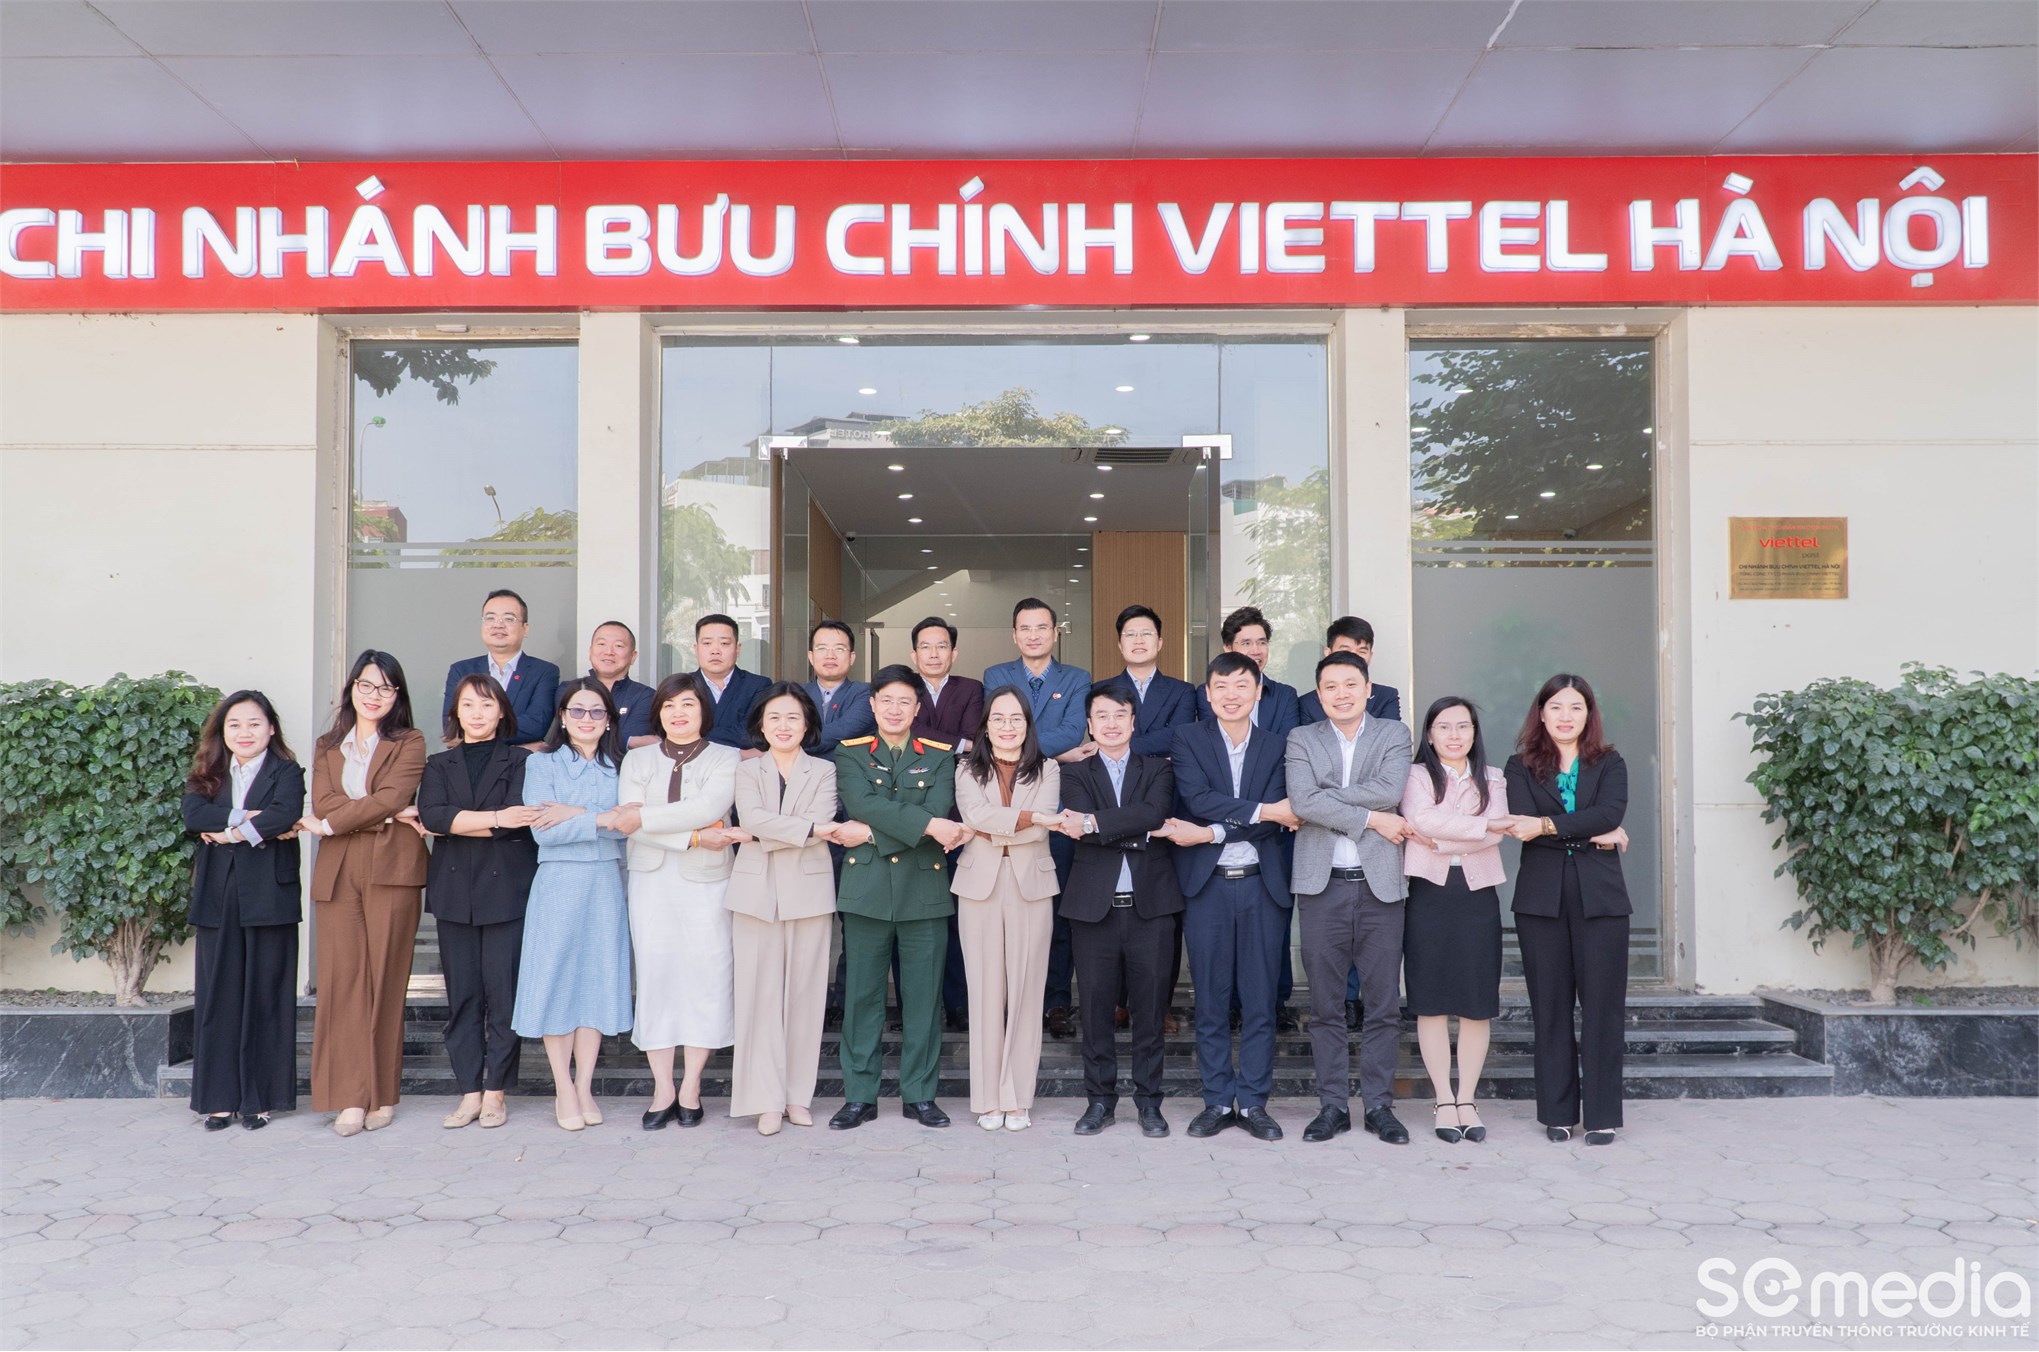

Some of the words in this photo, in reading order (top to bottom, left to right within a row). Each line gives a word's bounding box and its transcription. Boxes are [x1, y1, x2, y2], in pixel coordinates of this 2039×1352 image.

[0, 207, 156, 280] CHI
[182, 175, 558, 279] NHÁNH
[585, 193, 796, 277] BƯU
[825, 176, 1134, 276] CHÍNH
[1157, 200, 1609, 275] VIETTEL
[1628, 172, 1784, 272] HÀ
[1803, 166, 1990, 288] NỘI
[1759, 536, 1820, 549] viettel
